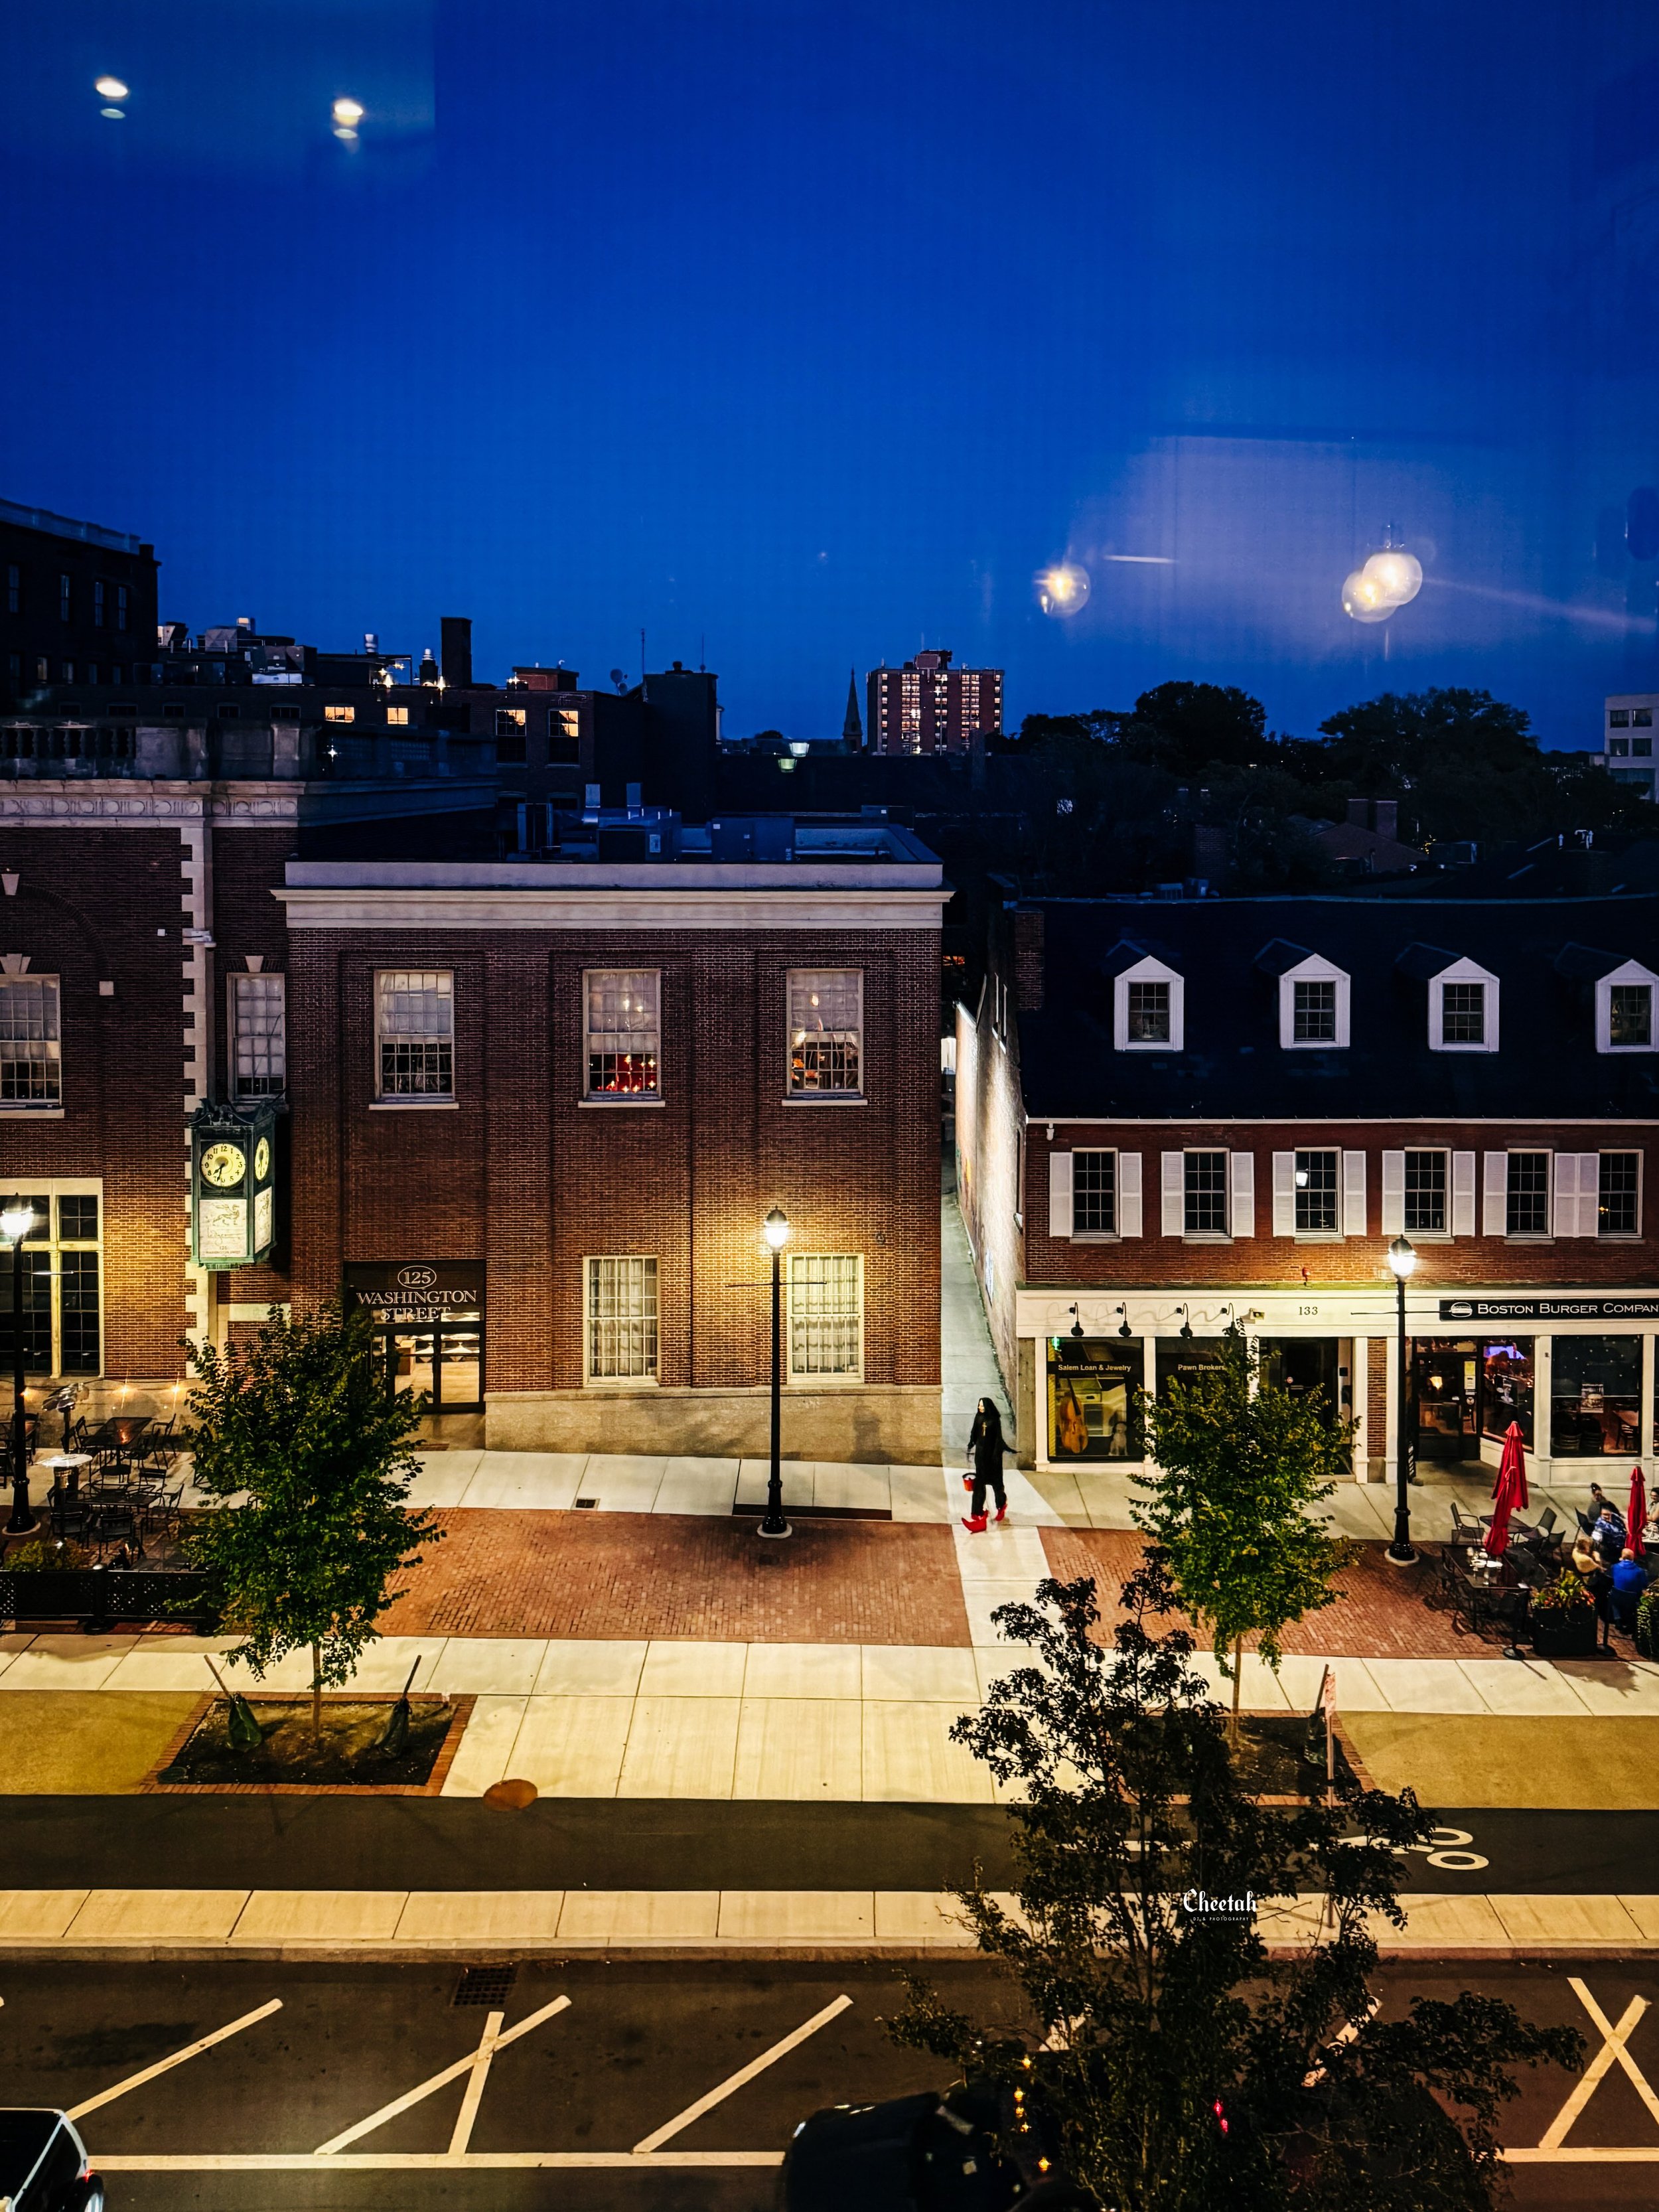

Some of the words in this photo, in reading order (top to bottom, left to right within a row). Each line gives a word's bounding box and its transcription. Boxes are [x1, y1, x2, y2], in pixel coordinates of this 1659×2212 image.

[403, 1272, 431, 1284] 125
[356, 1290, 477, 1304] WASHINGTON
[381, 1307, 451, 1321] STREET
[1299, 1306, 1318, 1315] 133
[1477, 1303, 1534, 1314] BOSTON
[1540, 1303, 1598, 1313] BURGER
[1603, 1303, 1659, 1313] COMPAN
